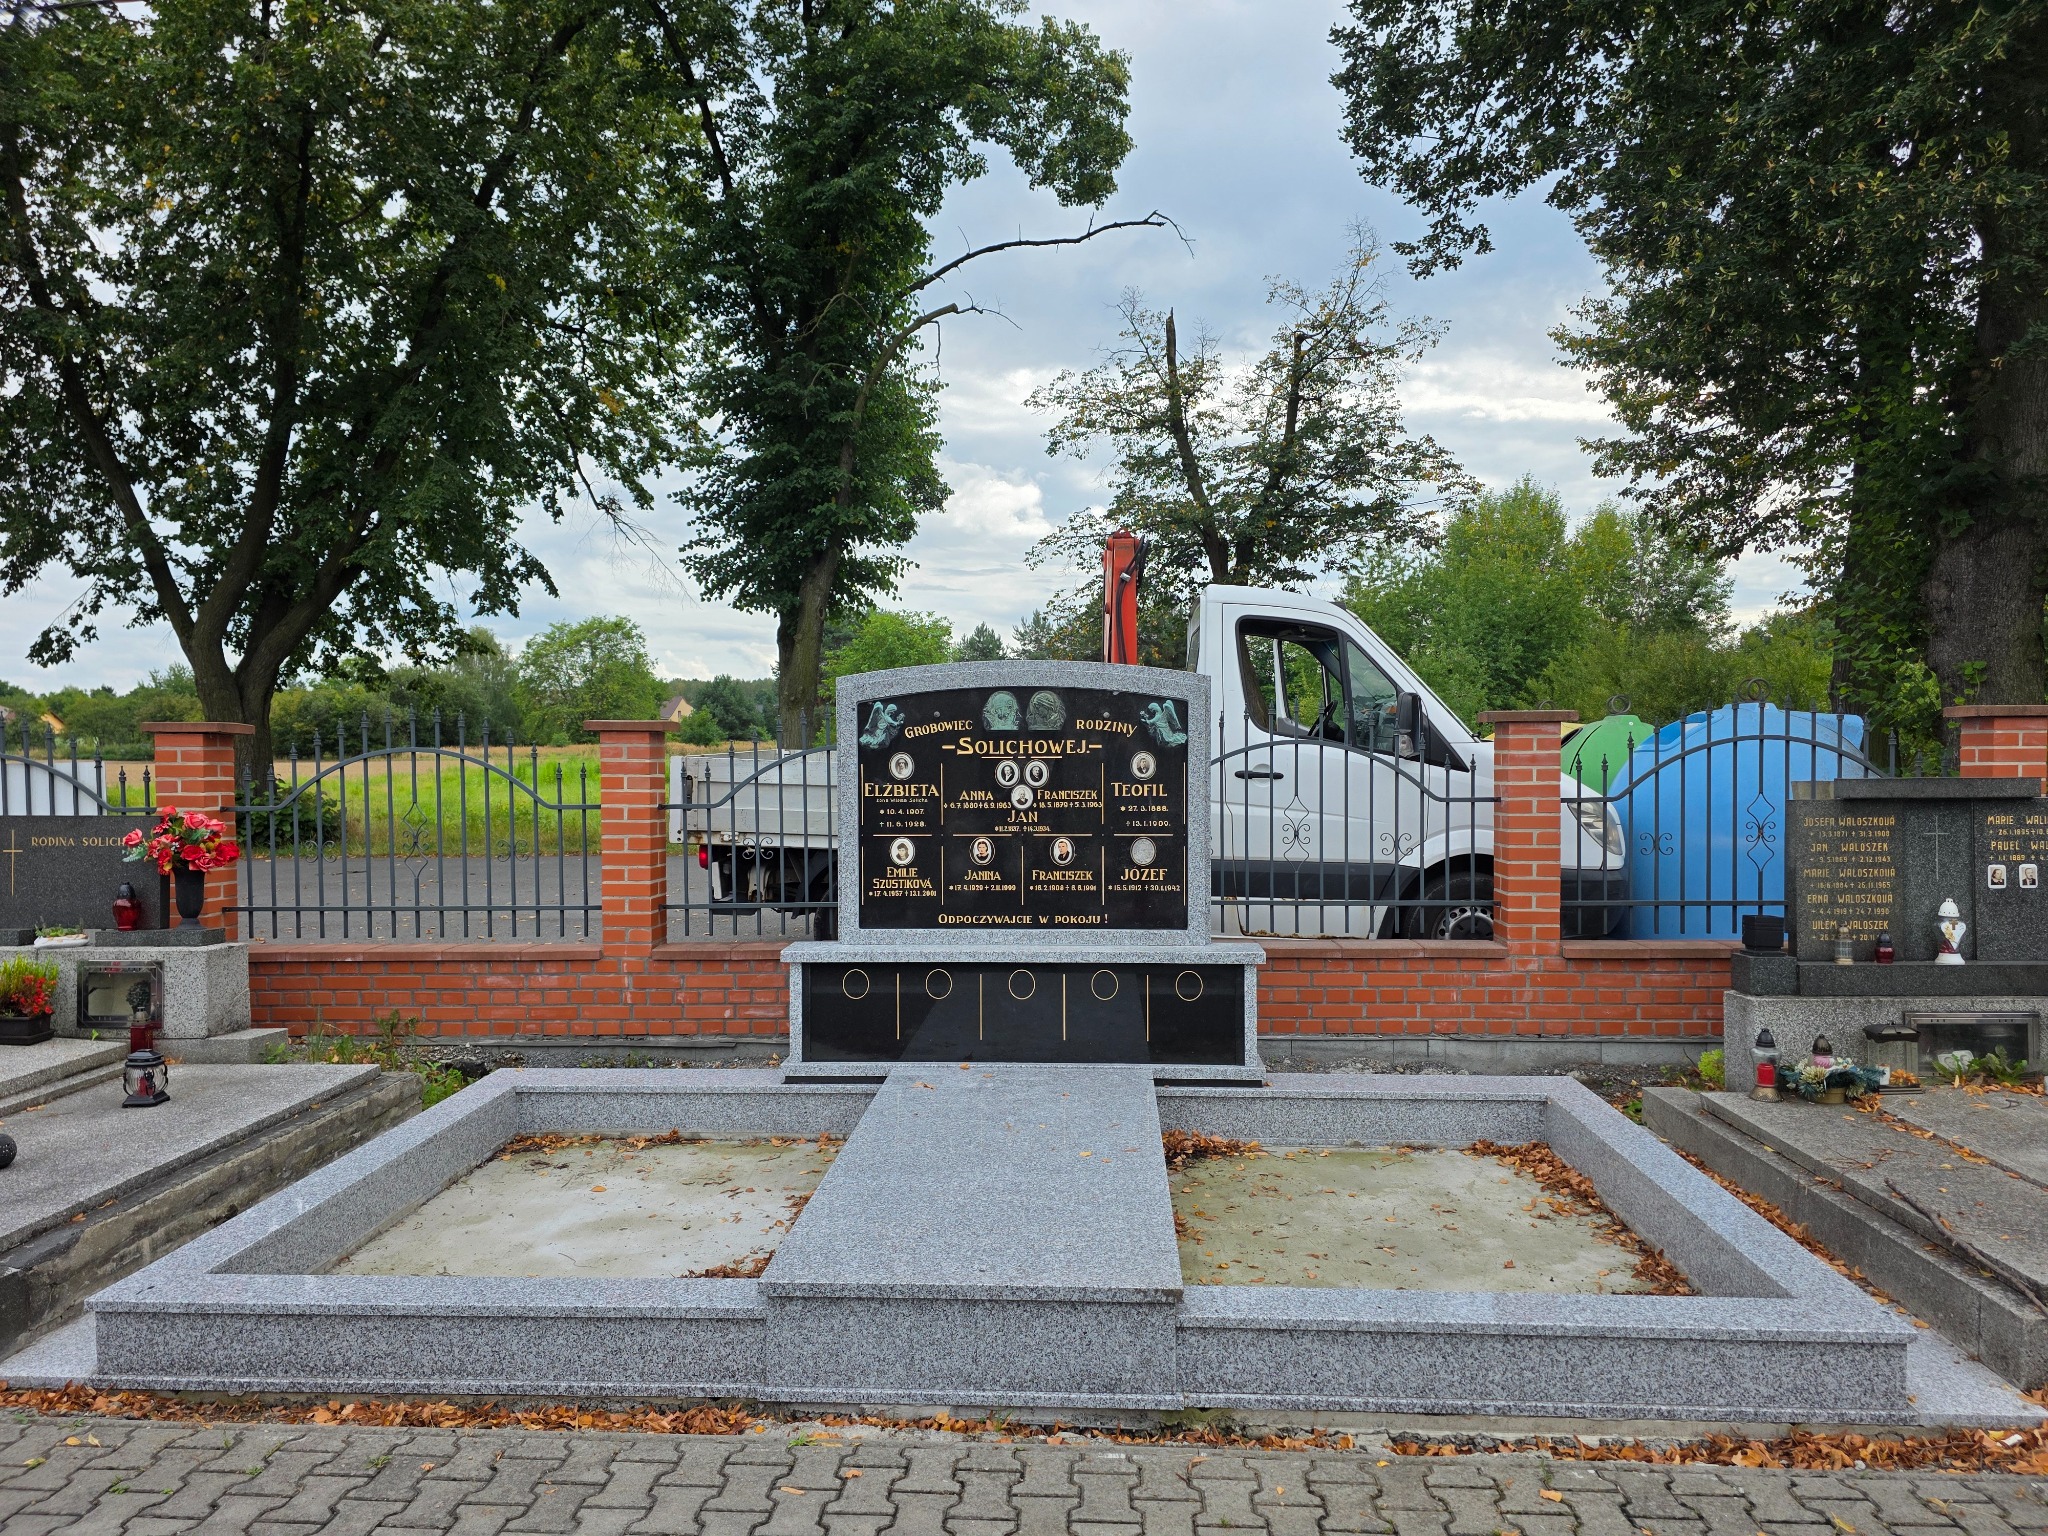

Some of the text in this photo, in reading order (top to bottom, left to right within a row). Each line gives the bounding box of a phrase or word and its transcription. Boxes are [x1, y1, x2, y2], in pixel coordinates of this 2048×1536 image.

[904, 719, 1138, 739] GROBOWIEC RODZINY
[864, 782, 940, 797] ELŻBIETA
[1037, 789, 1098, 800] FRANCISZEK
[1110, 782, 1168, 797] TEOFIL
[959, 790, 994, 801] ANNA
[1007, 810, 1038, 823] JAN
[1803, 817, 1835, 827] JOSEFA
[1987, 815, 2014, 825] MARIE
[31, 836, 75, 847] RODINA
[1810, 842, 1889, 852] JAN WALOSZEK
[886, 866, 918, 878] EMILIE
[964, 869, 1002, 881] JANINA
[1032, 869, 1093, 881] FRANCISZEK
[1120, 866, 1168, 881] JÓZEF
[1803, 868, 1830, 878] MARIE
[873, 877, 933, 889] SZUSTIKOVÁ
[1807, 894, 1829, 904] ERNA
[937, 913, 1033, 924] ODPOCZYWAJCIE
[1038, 915, 1049, 924] W
